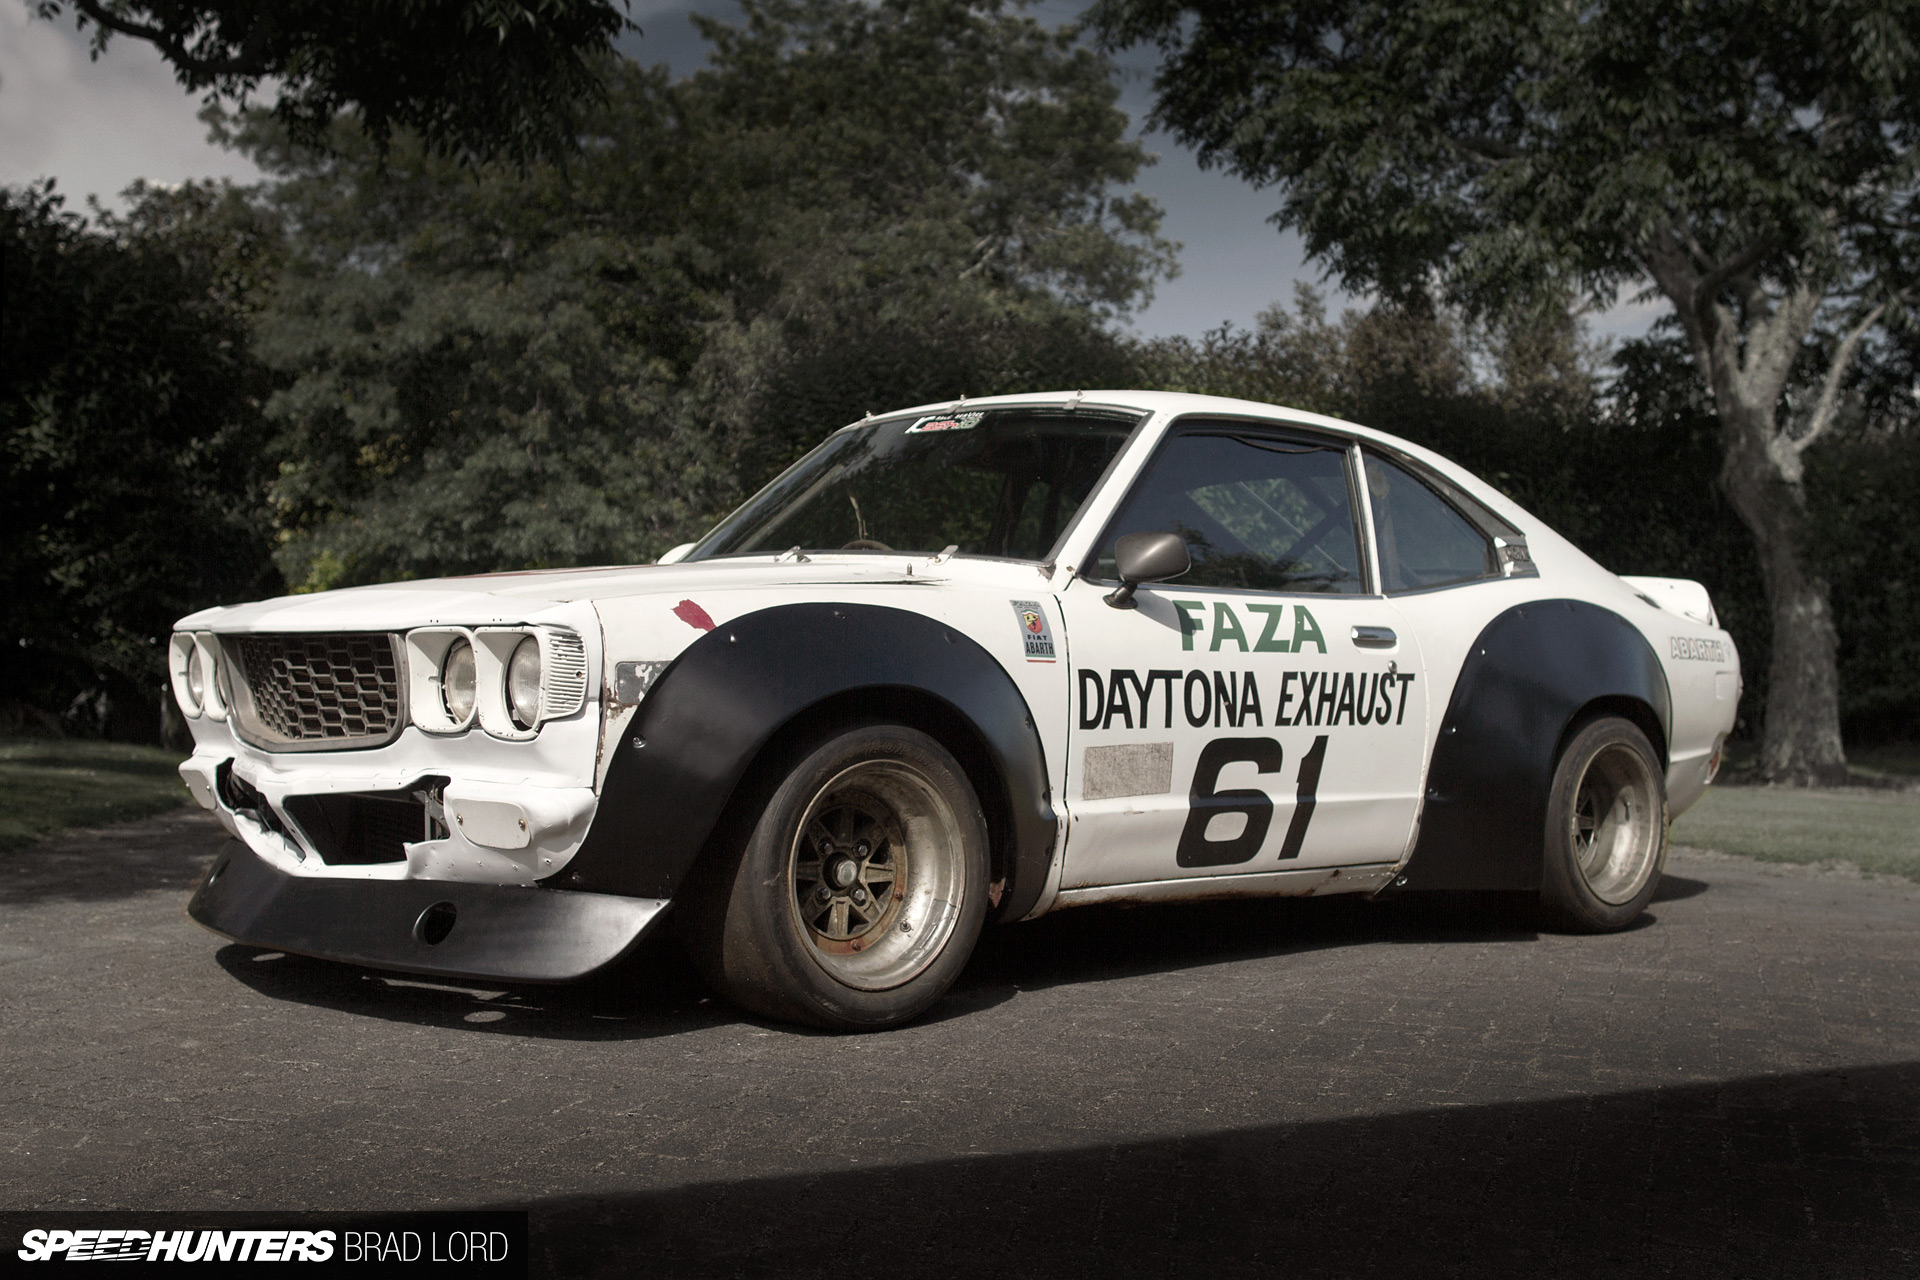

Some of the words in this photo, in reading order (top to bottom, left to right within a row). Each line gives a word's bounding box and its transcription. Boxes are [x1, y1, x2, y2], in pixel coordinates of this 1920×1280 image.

[1025, 642, 1054, 655] ABARTH
[1172, 600, 1328, 654] FAZA
[1670, 637, 1725, 662] ABARTH
[1078, 668, 1264, 730] DAYTONA
[1275, 671, 1415, 727] EXHAUST
[1176, 735, 1329, 868] 61
